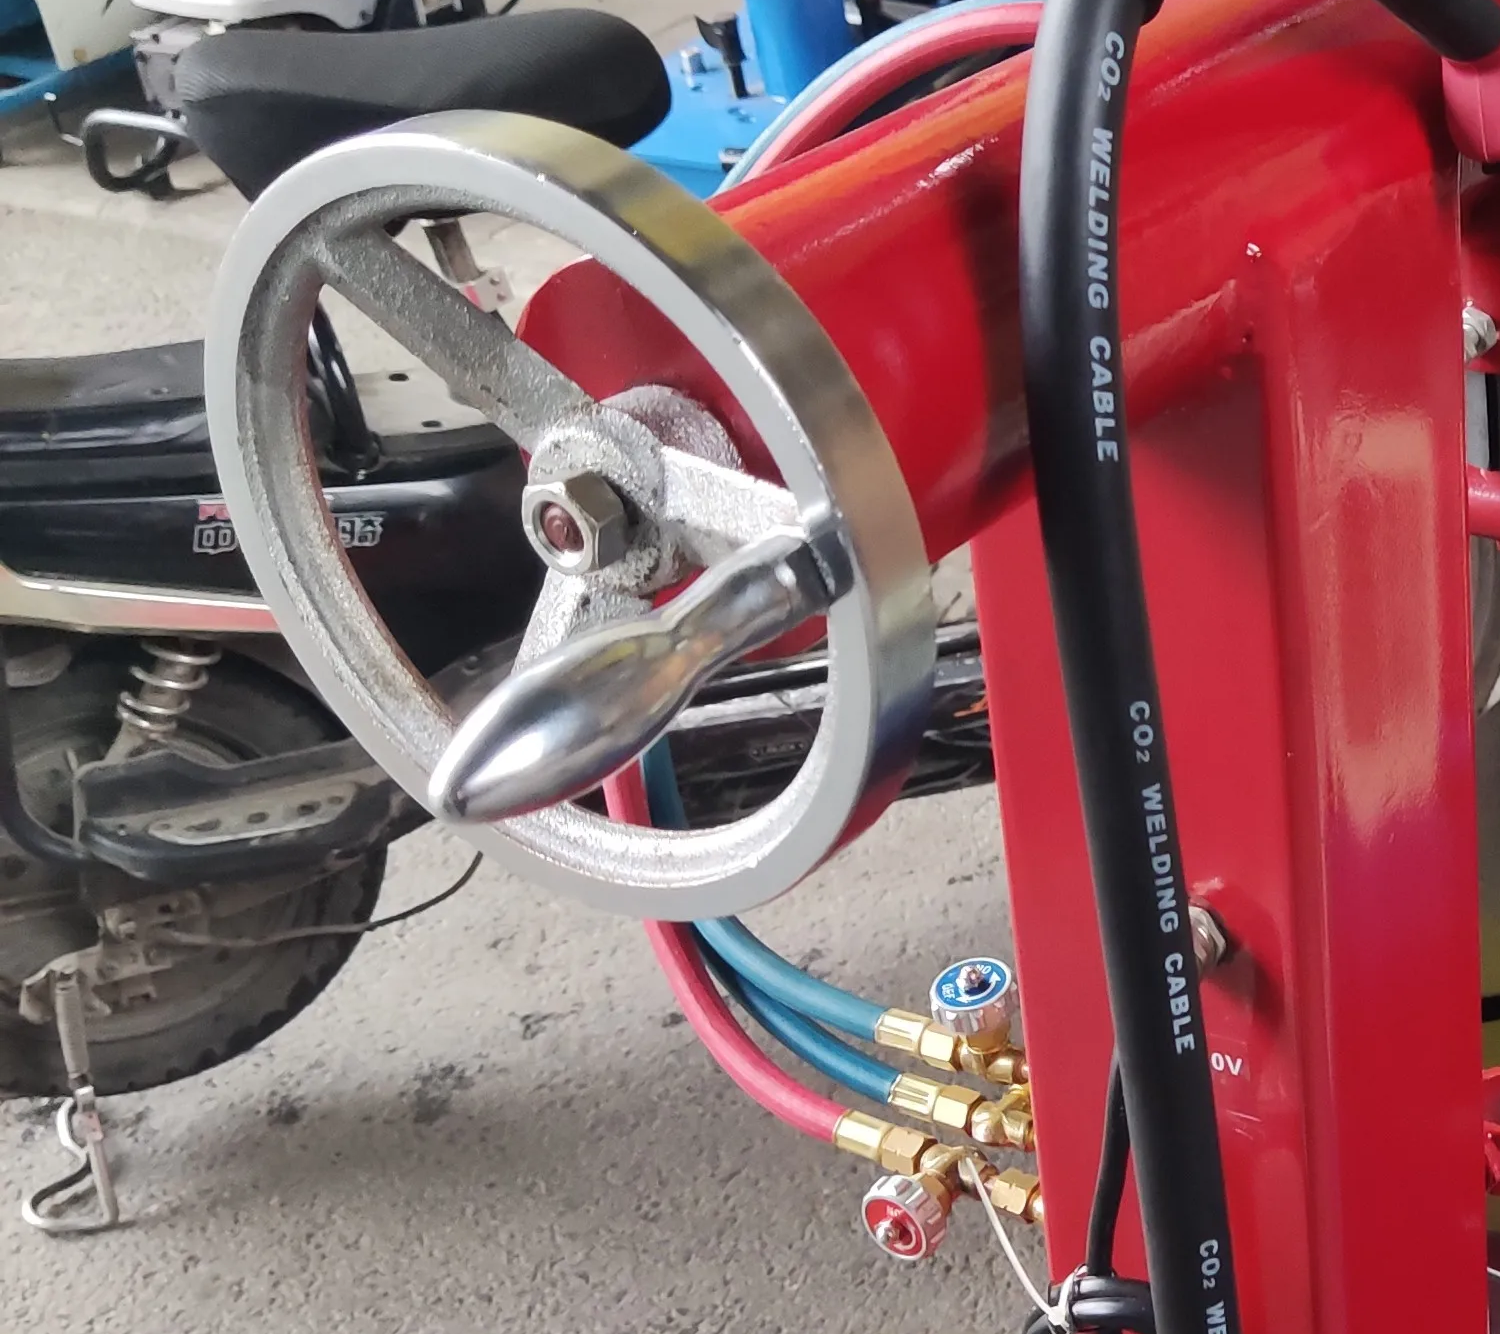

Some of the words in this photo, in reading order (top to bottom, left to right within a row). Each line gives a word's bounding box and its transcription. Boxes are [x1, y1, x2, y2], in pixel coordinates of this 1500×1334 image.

[1086, 126, 1115, 310] WELDING
[1088, 336, 1118, 463] CABLE
[1141, 782, 1179, 934] WELDING
[1164, 952, 1196, 1055] CABLE
[1211, 1051, 1243, 1077] 0V
